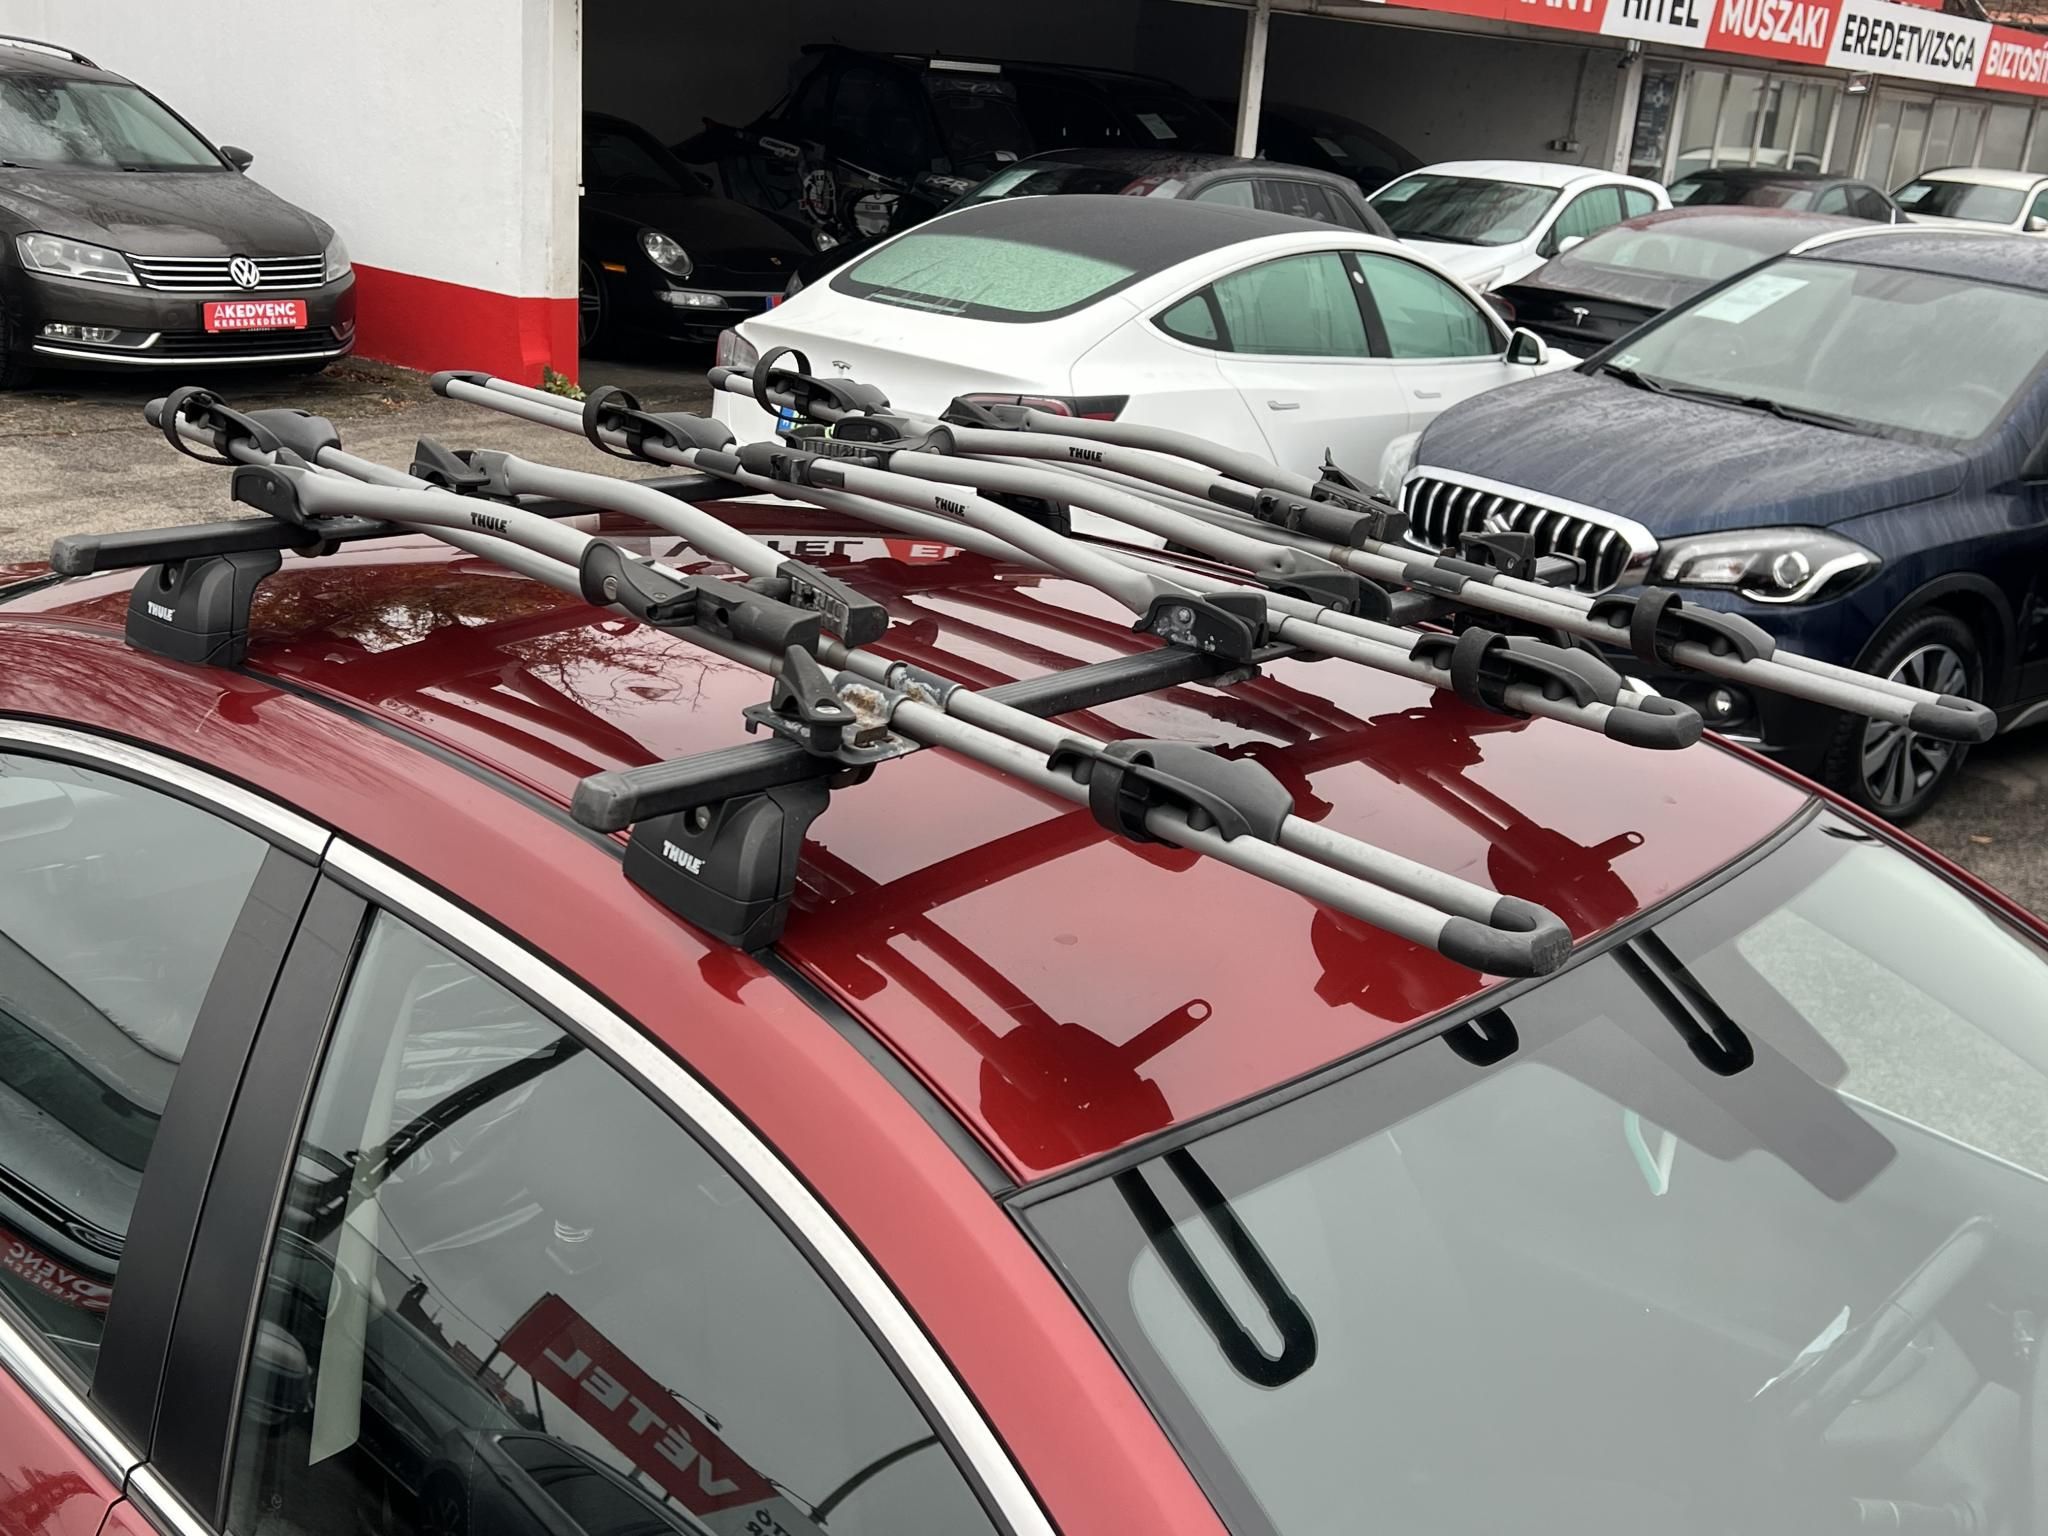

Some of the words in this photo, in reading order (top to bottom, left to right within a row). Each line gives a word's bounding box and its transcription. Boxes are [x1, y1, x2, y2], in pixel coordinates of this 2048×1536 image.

[1841, 14, 1976, 71] EREDETVIZSGA
[1069, 446, 1103, 462] THULE
[934, 496, 966, 517] THULE
[470, 511, 508, 534] THULE
[148, 600, 173, 621] THULE
[663, 839, 701, 875] THULE
